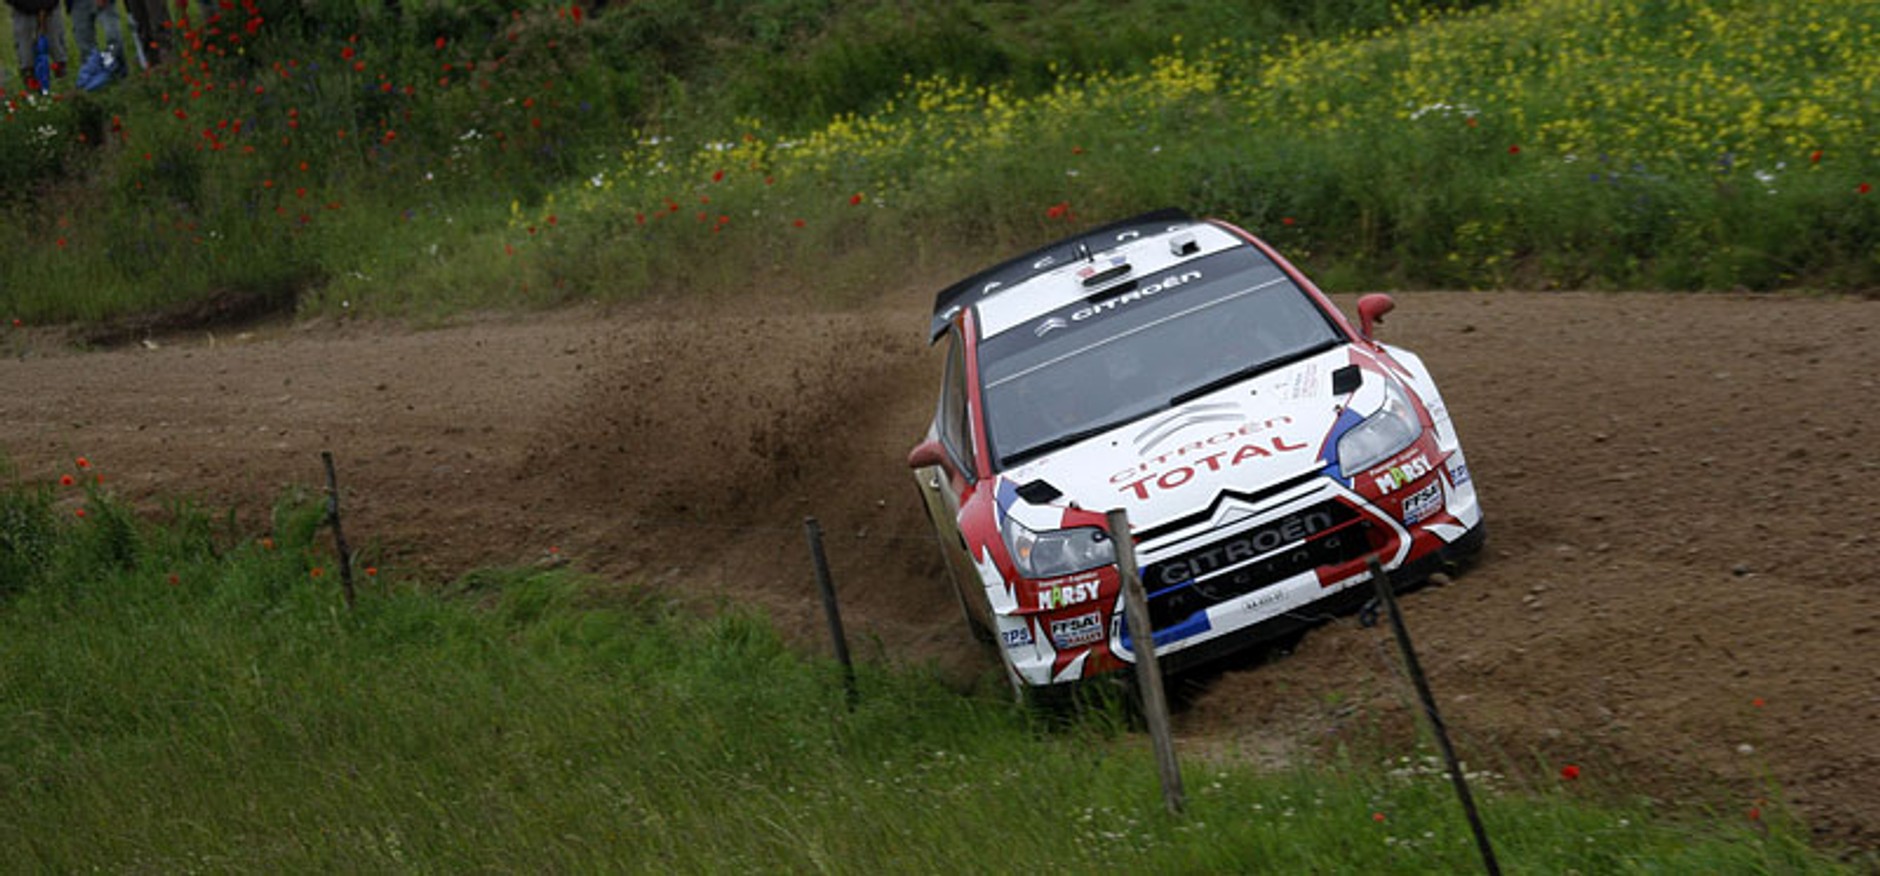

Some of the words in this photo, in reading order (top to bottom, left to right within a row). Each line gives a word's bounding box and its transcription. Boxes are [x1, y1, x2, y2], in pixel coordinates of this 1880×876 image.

[1119, 436, 1308, 499] TOTAL
[1375, 453, 1433, 495] MARSY
[1038, 579, 1101, 610] MARSY
